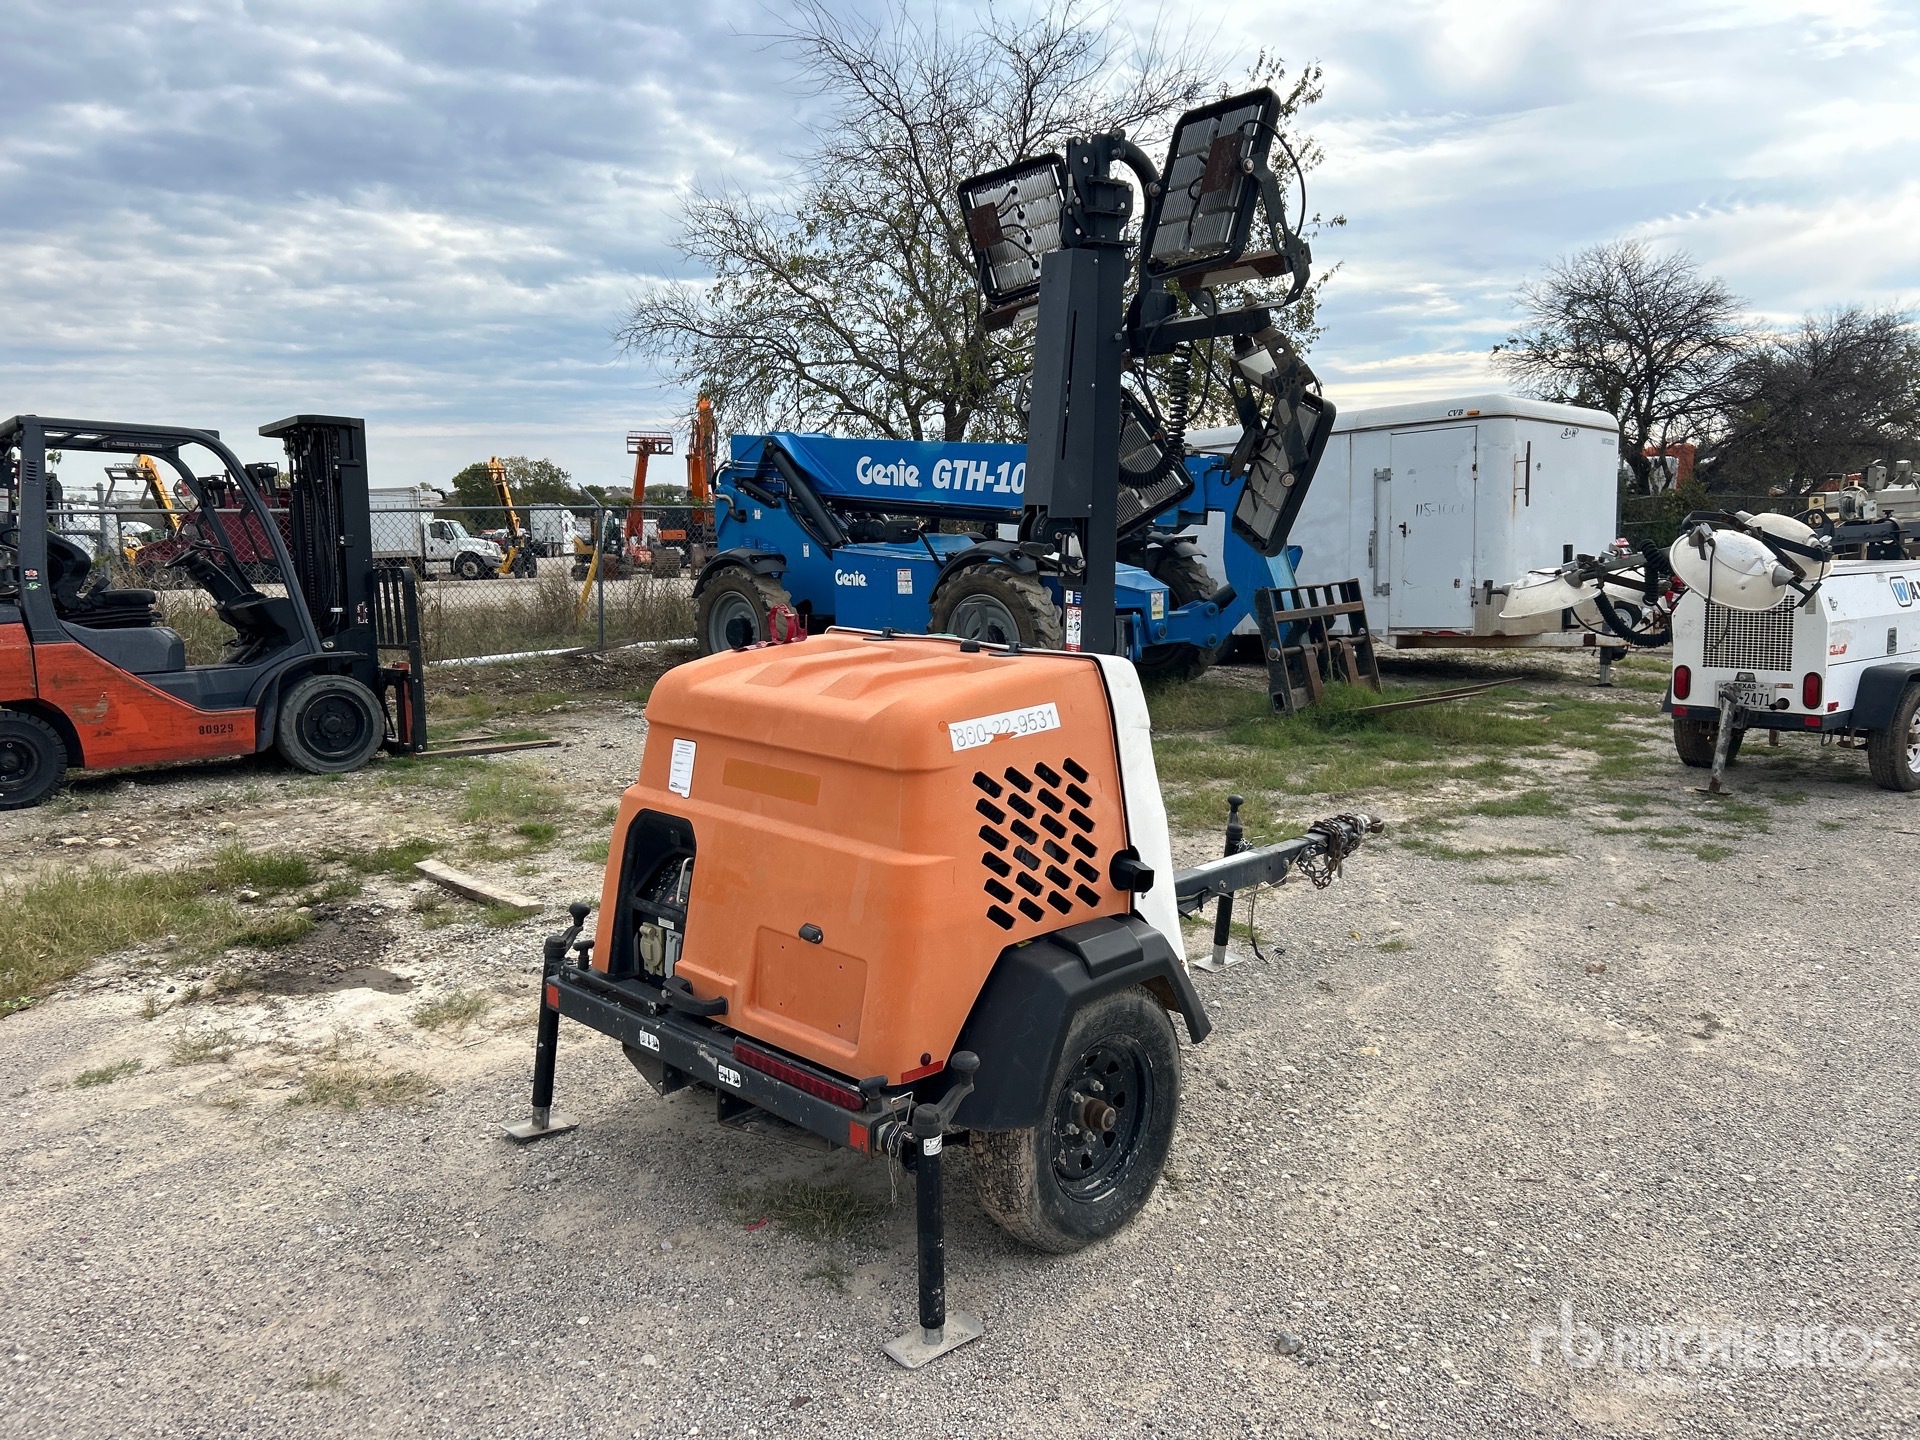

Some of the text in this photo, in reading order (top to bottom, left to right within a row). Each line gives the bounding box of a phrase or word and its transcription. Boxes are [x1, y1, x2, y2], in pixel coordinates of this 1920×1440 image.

[856, 455, 920, 488] Genie
[835, 568, 867, 587] Genie
[199, 723, 234, 735] 80929
